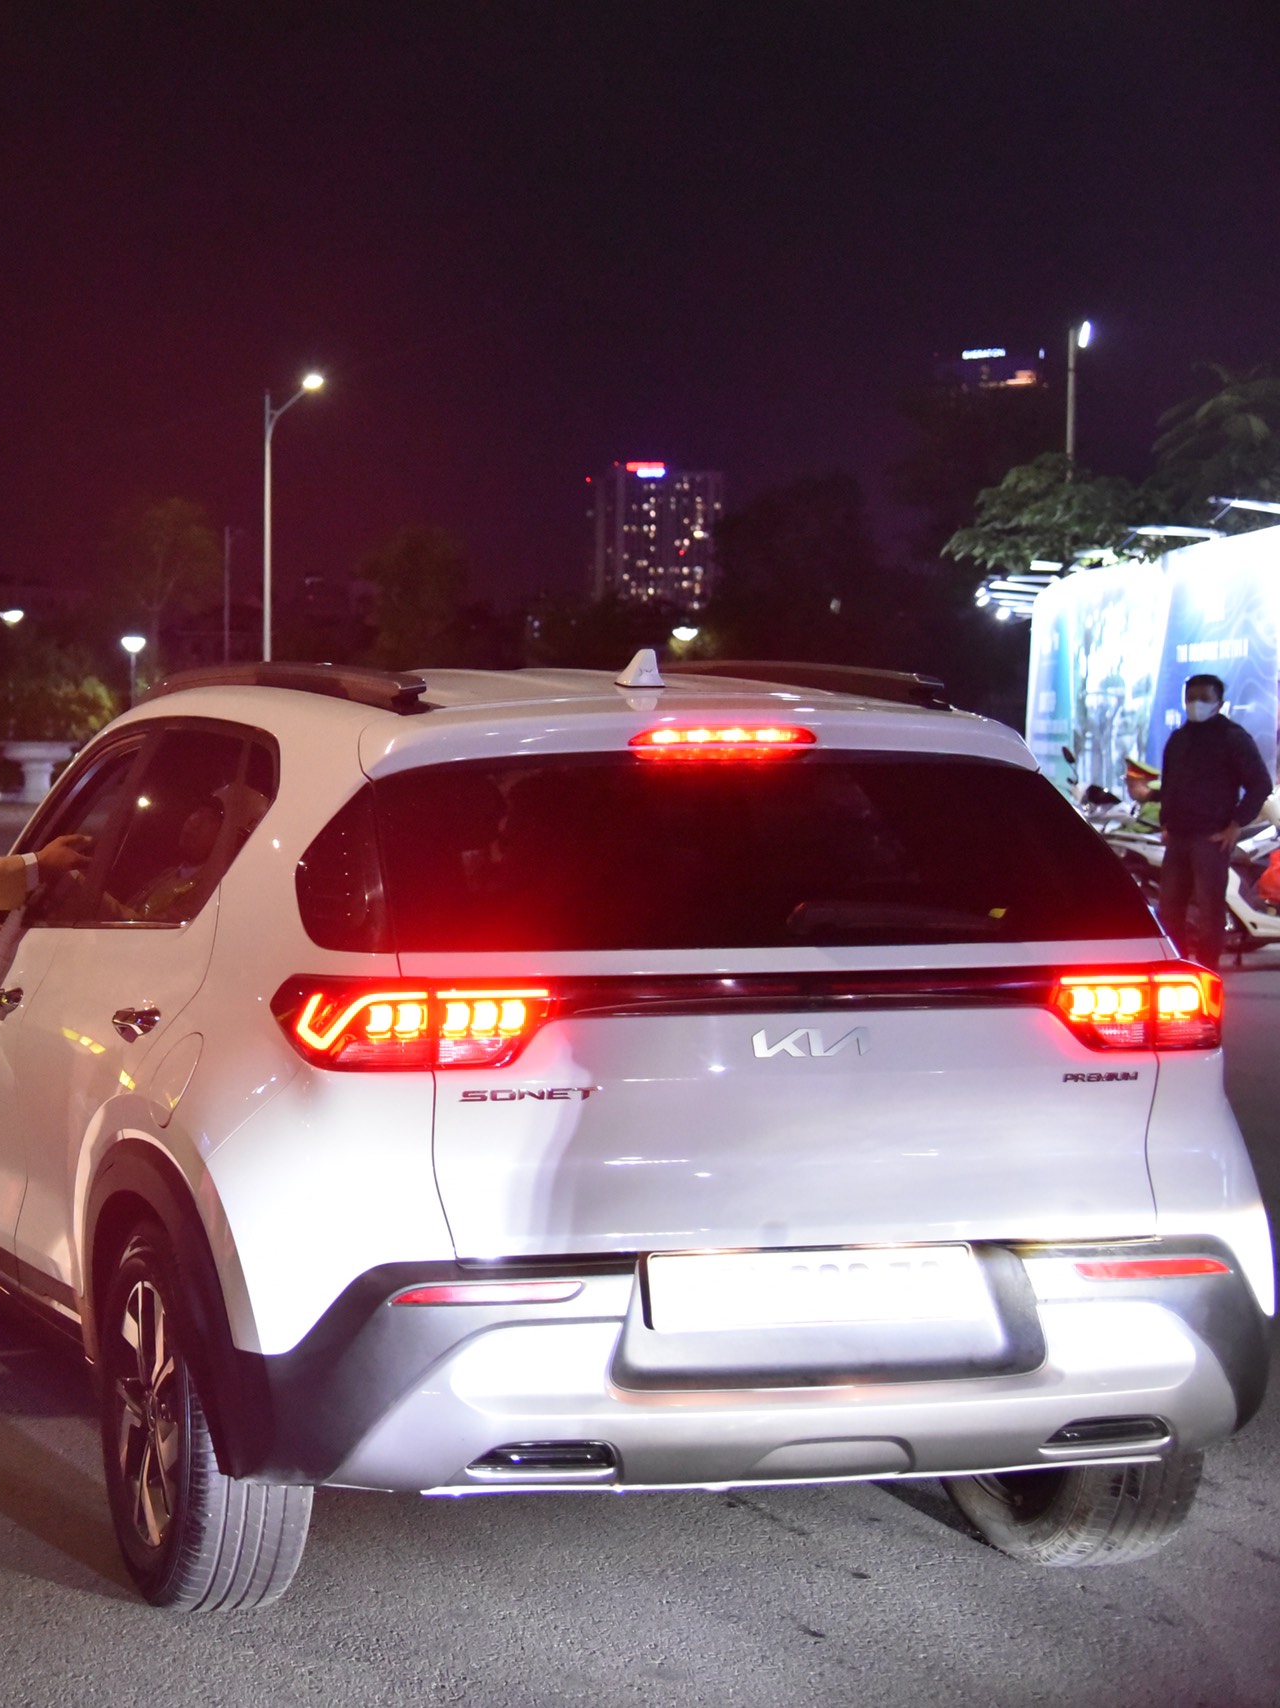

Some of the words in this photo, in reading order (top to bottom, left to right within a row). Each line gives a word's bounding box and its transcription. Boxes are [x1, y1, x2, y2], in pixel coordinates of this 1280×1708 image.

[751, 1026, 871, 1058] KIA
[1062, 1071, 1139, 1083] PREMIUM
[458, 1085, 602, 1103] SONET
